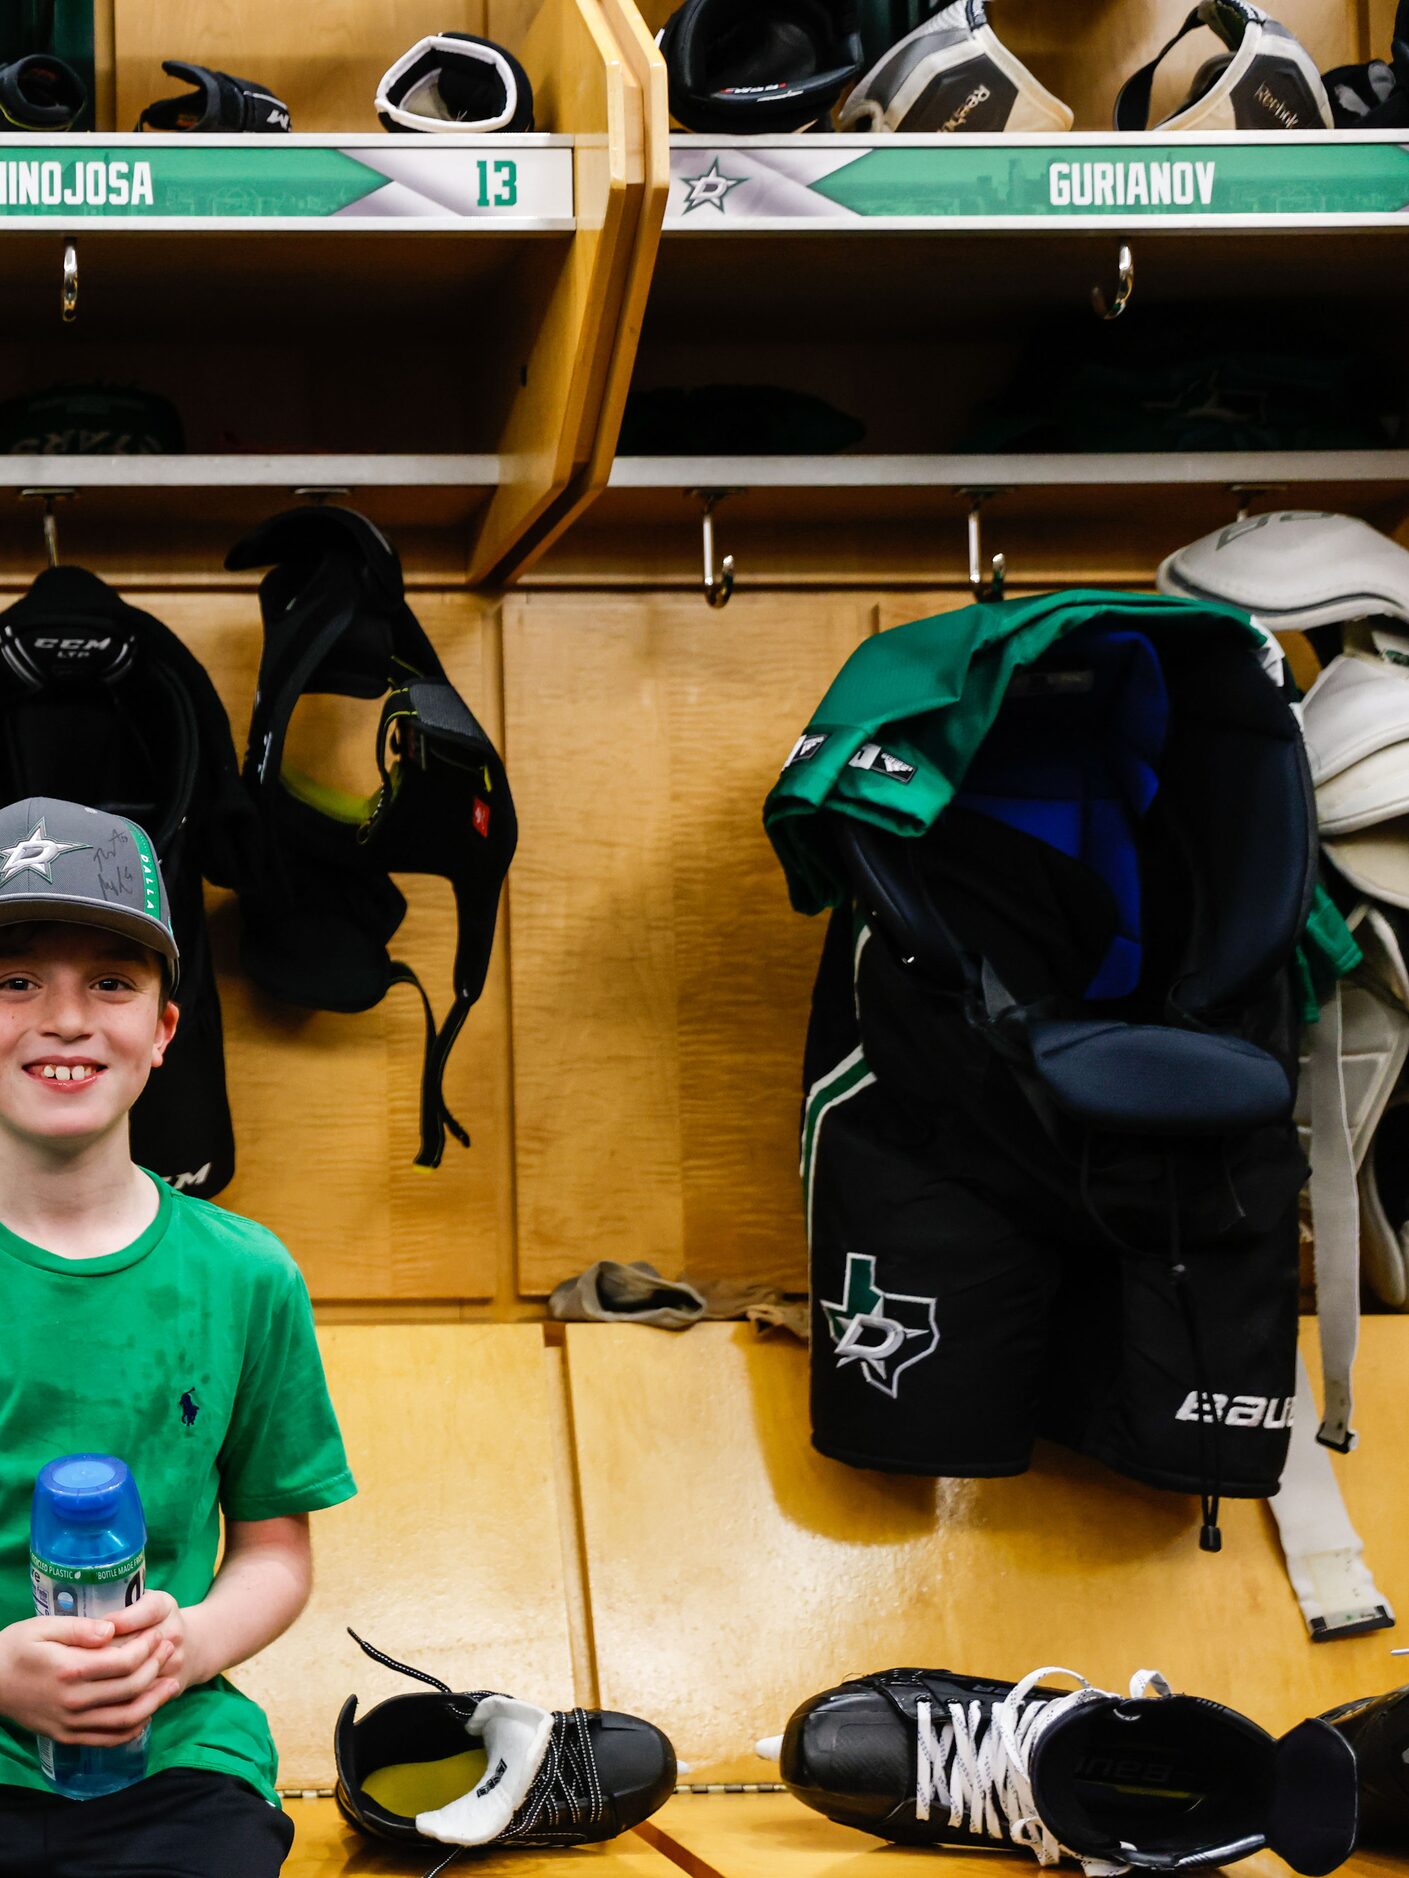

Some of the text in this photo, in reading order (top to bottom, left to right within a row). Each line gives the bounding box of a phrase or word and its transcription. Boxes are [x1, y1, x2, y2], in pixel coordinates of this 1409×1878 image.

[476, 159, 518, 207] 13
[1048, 160, 1216, 206] GURIANOV
[34, 637, 111, 650] CCM
[48, 1566, 74, 1580] PLASTIC
